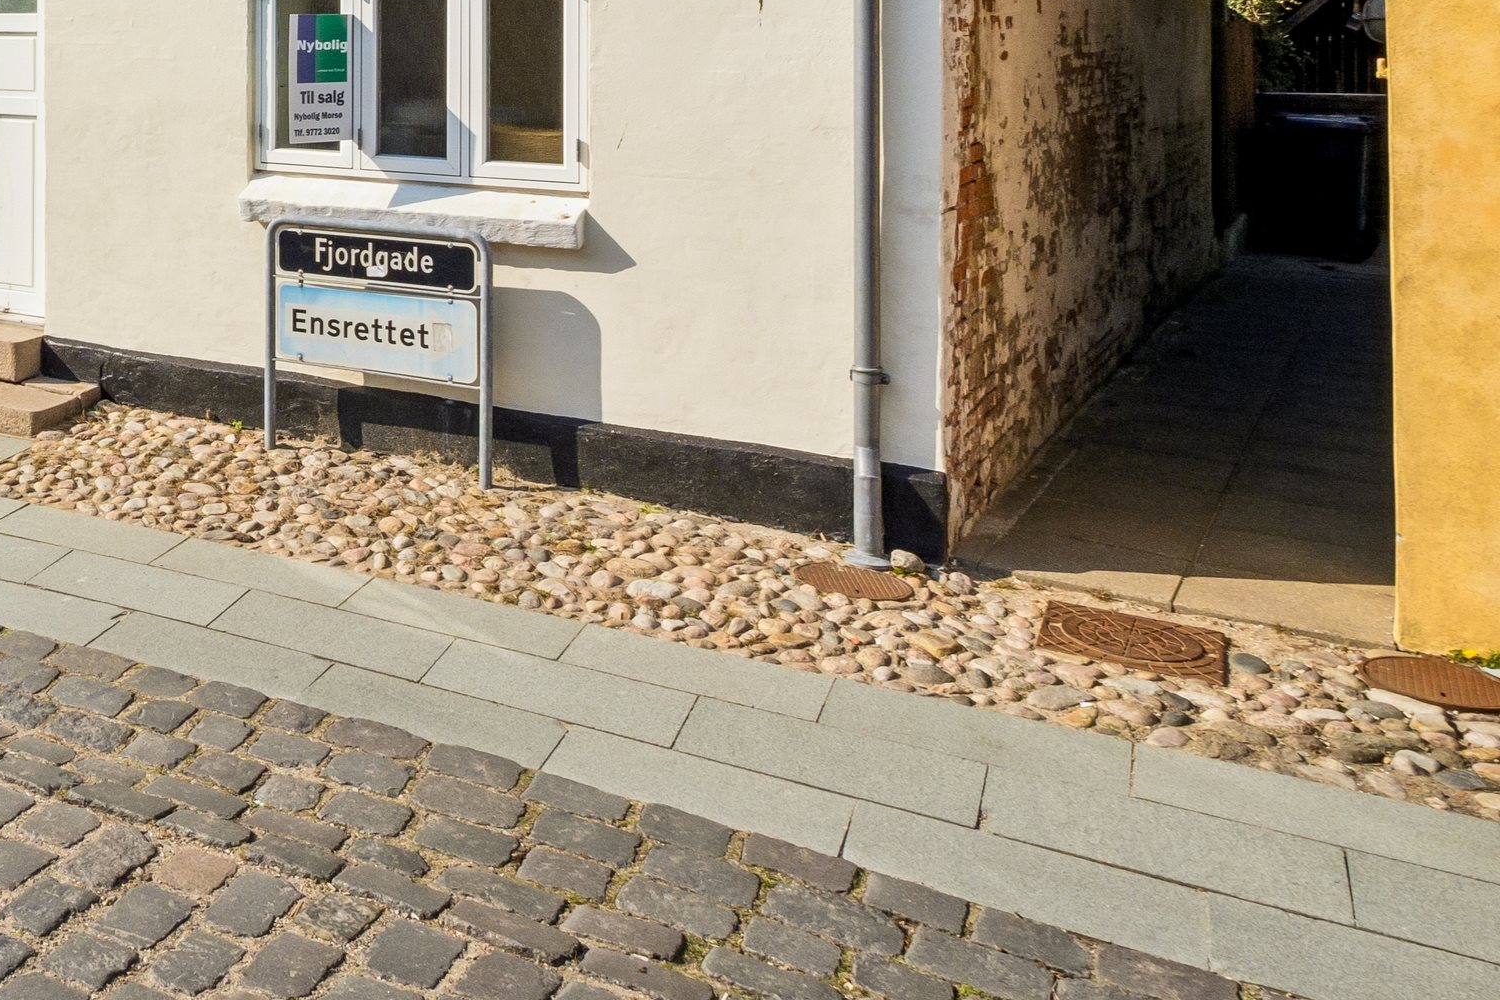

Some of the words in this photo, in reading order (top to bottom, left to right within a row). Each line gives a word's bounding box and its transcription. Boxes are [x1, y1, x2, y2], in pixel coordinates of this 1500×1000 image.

[296, 39, 348, 53] Nybolig
[300, 91, 314, 104] Til
[318, 90, 345, 106] salg
[294, 112, 320, 122] Nybolig
[322, 111, 343, 120] Morsø
[294, 128, 305, 137] Tlf.
[305, 127, 322, 136] 9772
[323, 126, 340, 135] 3020
[314, 237, 434, 277] Fjordgade
[291, 308, 430, 350] Ensrettet
